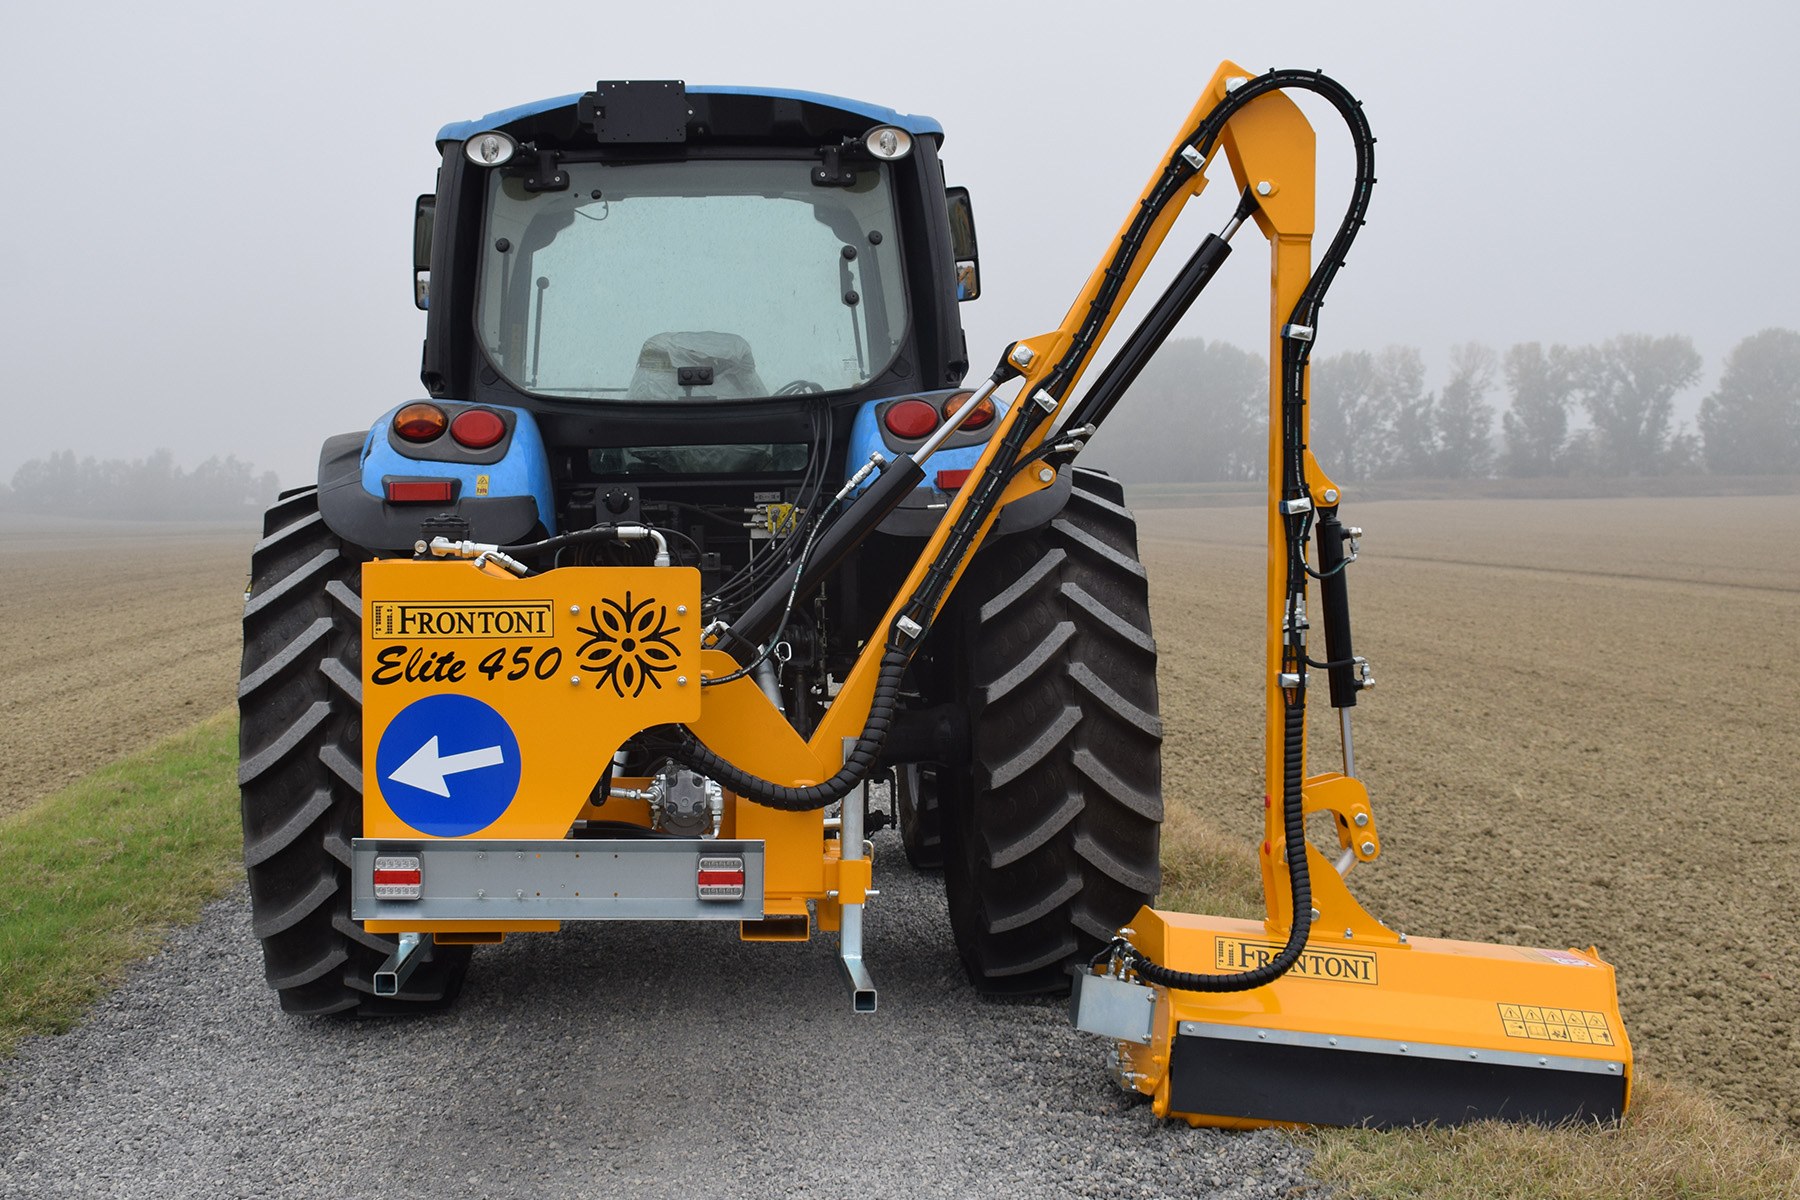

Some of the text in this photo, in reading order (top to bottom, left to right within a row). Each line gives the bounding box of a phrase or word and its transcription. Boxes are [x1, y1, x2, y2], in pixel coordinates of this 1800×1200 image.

[397, 605, 549, 635] FRONTONI
[371, 645, 563, 686] Elite 450
